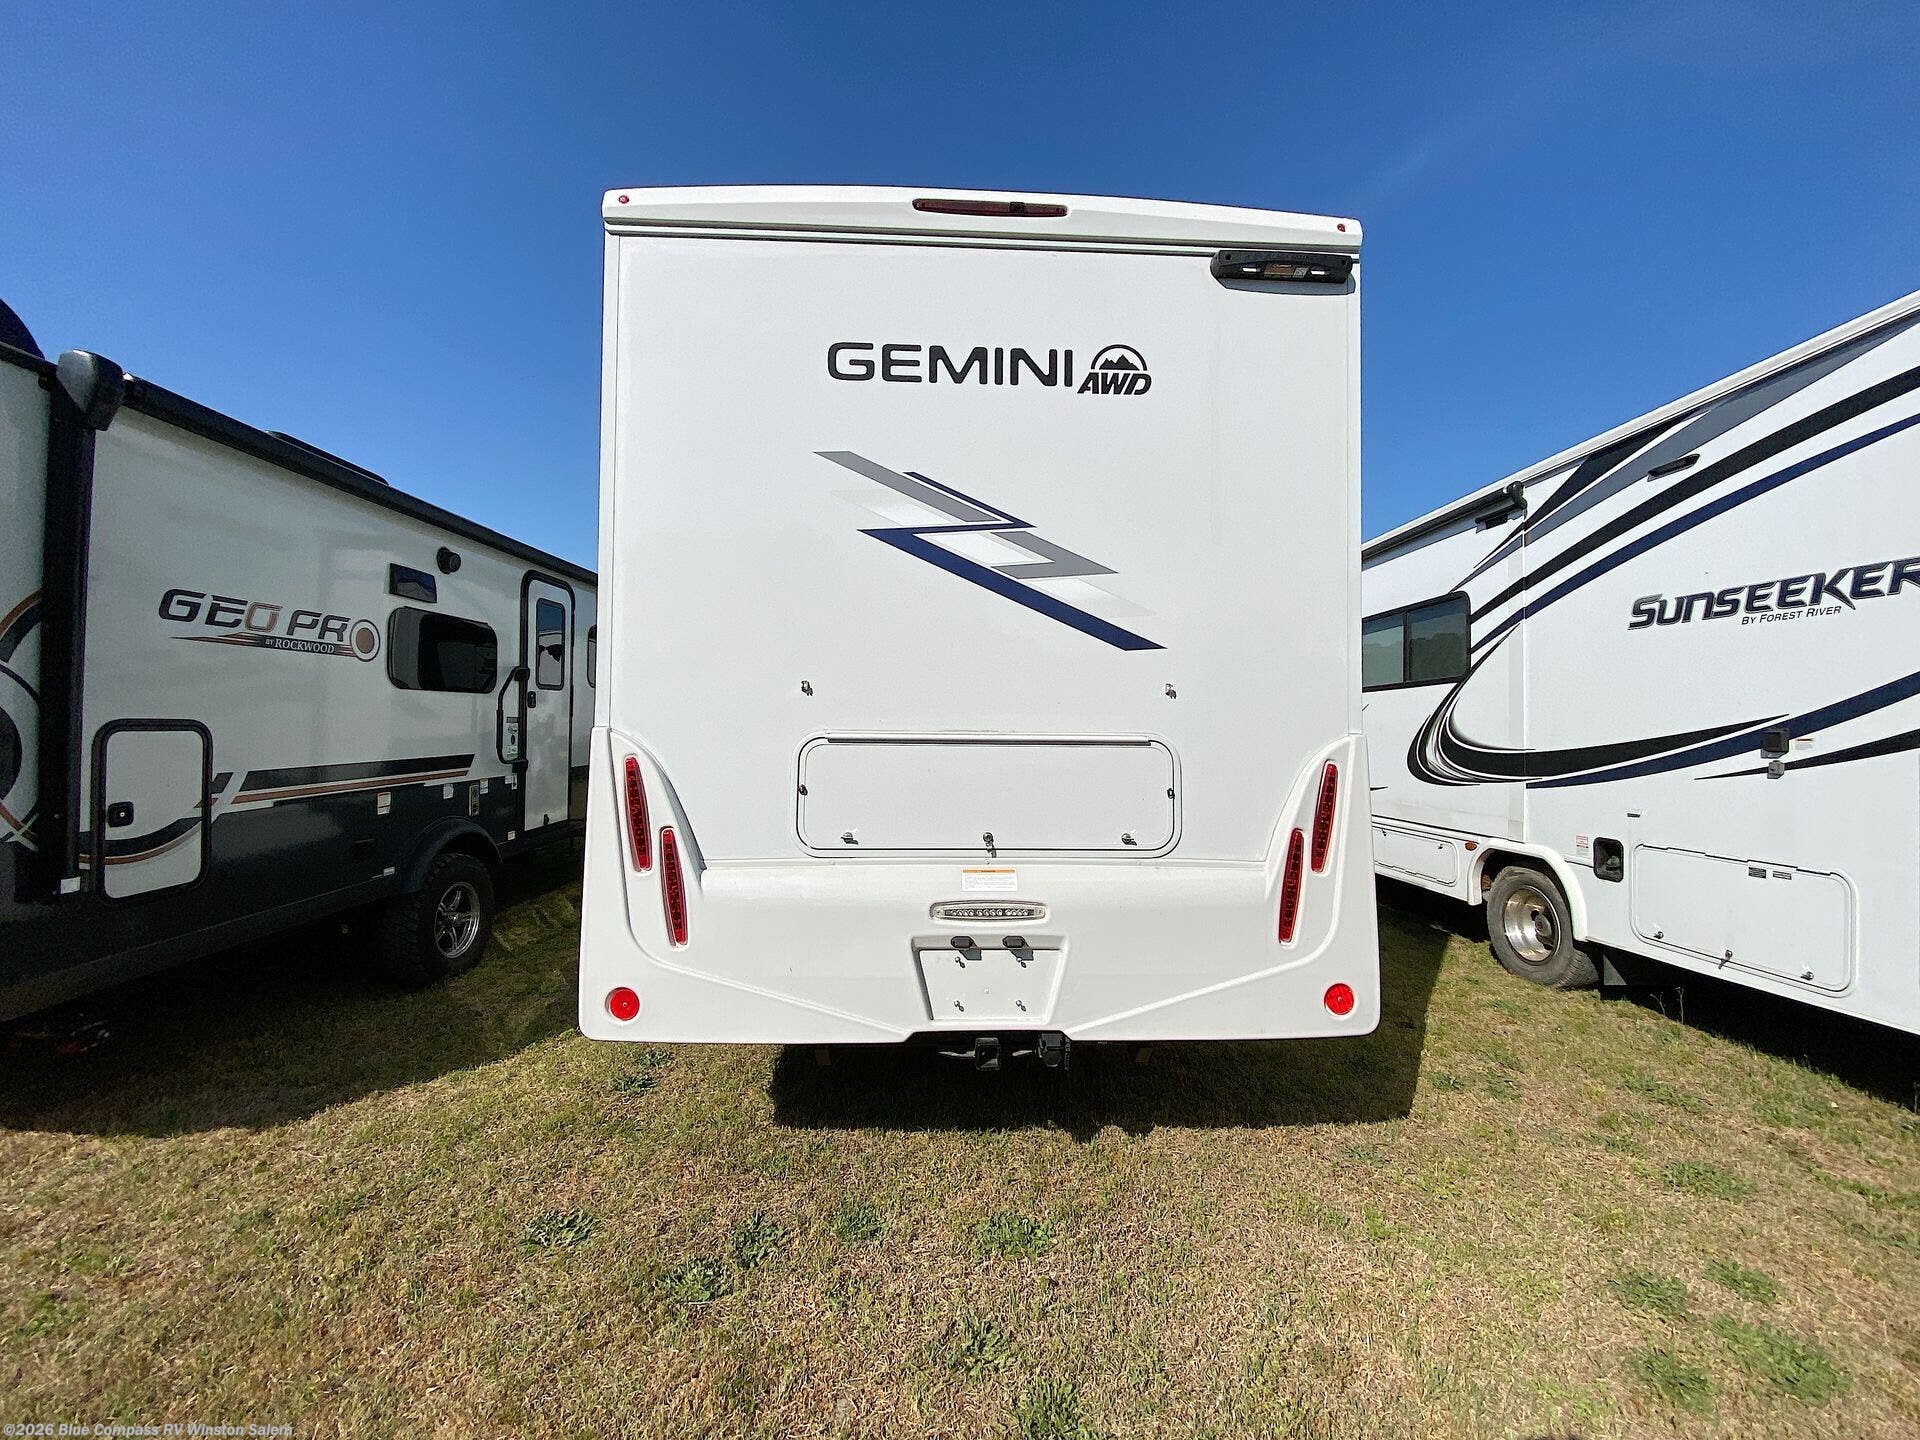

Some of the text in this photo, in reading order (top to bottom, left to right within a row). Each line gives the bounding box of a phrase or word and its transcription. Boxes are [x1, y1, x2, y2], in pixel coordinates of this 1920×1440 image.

[827, 341, 1152, 396] GEMINI AWD
[158, 588, 284, 633] GEO
[1741, 605, 1842, 626] BY FOREST RIVER
[265, 638, 335, 654] BY ROCKWOOD
